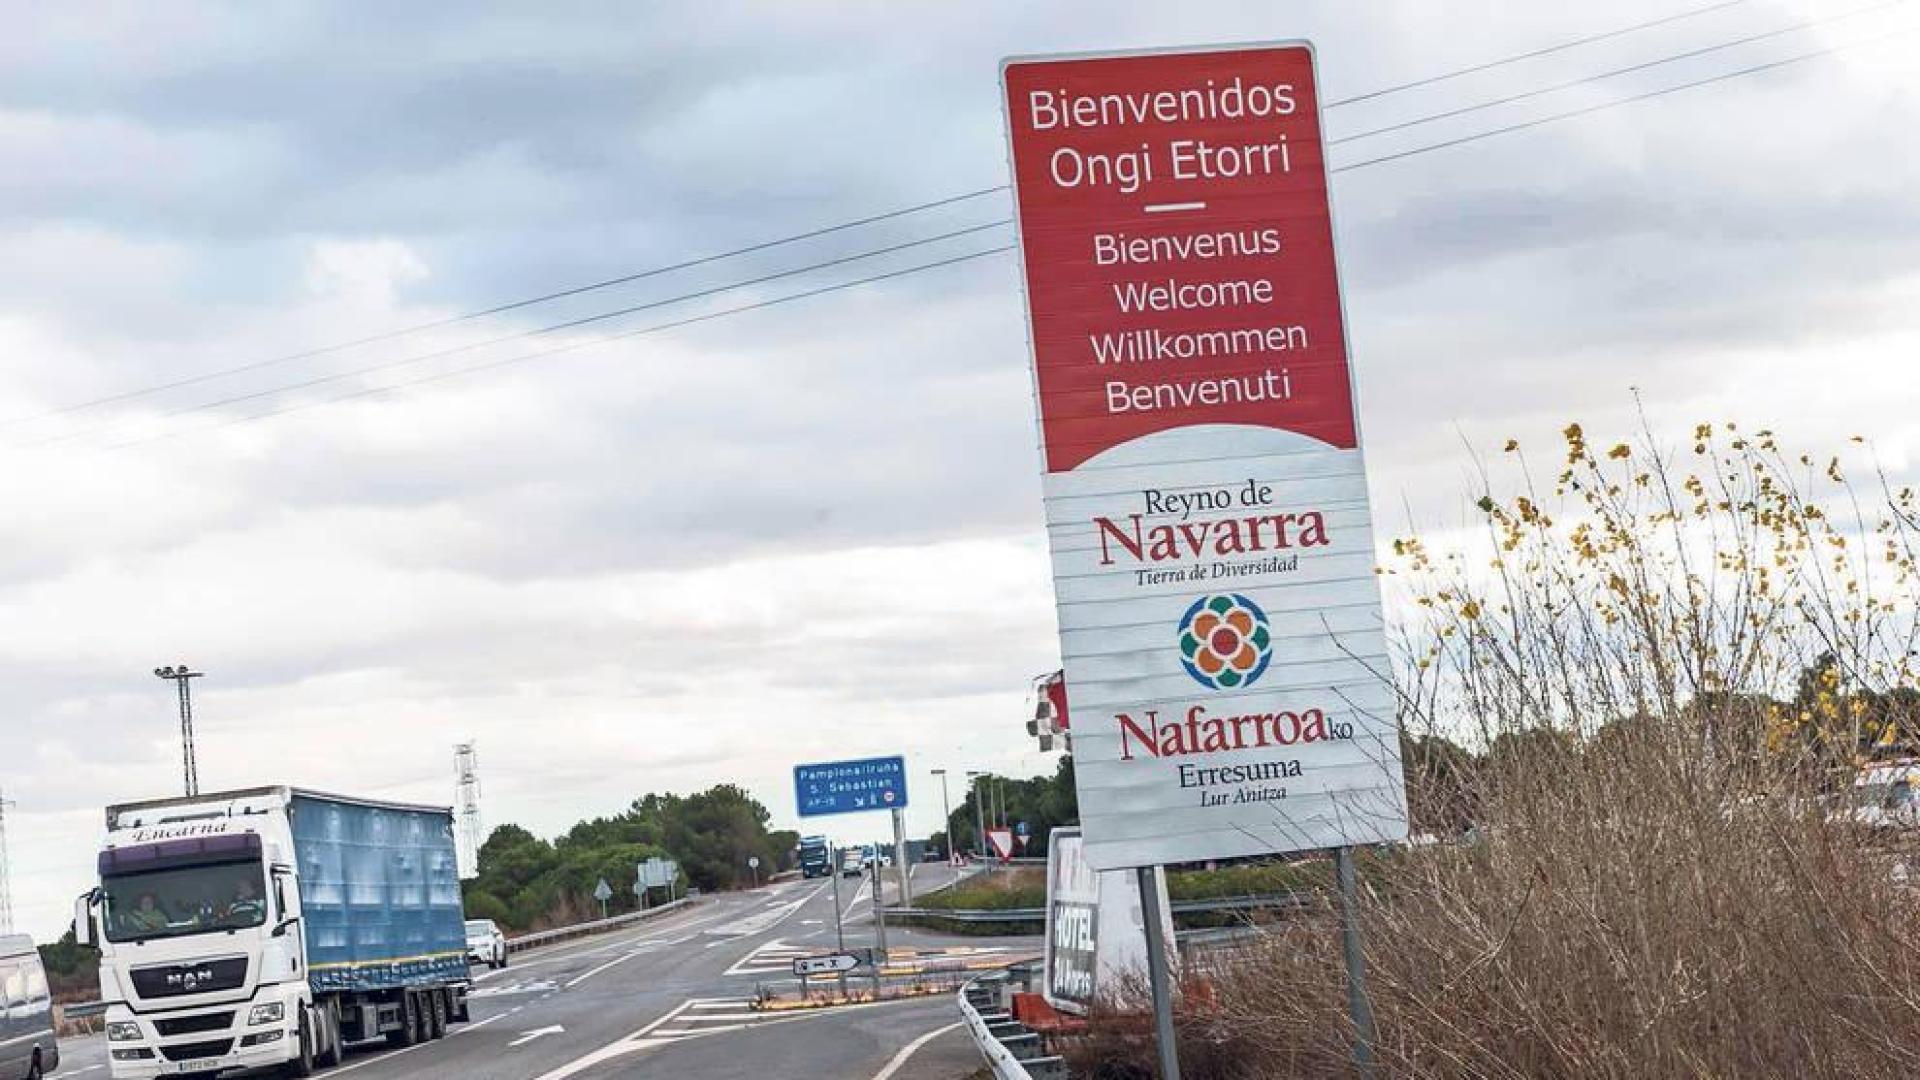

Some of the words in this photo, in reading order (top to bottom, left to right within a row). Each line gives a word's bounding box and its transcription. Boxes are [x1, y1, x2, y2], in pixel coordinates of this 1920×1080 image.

[1029, 77, 1296, 130] Bienvenidos
[1050, 143, 1152, 193] Ongi
[1170, 134, 1290, 180] Etorri
[1094, 228, 1281, 265] Bienvenus
[1113, 278, 1273, 313] Welcome
[1090, 325, 1308, 364] Willkommen
[1105, 368, 1291, 413] Benvenuti
[1143, 488, 1231, 521] Reyno
[1240, 479, 1273, 507] de
[1093, 510, 1330, 566] Navarra
[1134, 565, 1185, 587] Tierra
[1188, 561, 1206, 581] de
[1211, 554, 1298, 579] Diversidad
[1114, 705, 1353, 761] Nafarroako
[1178, 759, 1304, 788] Erresuma
[1200, 790, 1231, 808] Lur
[1233, 786, 1287, 805] Anitza
[1054, 904, 1095, 952] HOTEL
[166, 970, 213, 985] MAN
